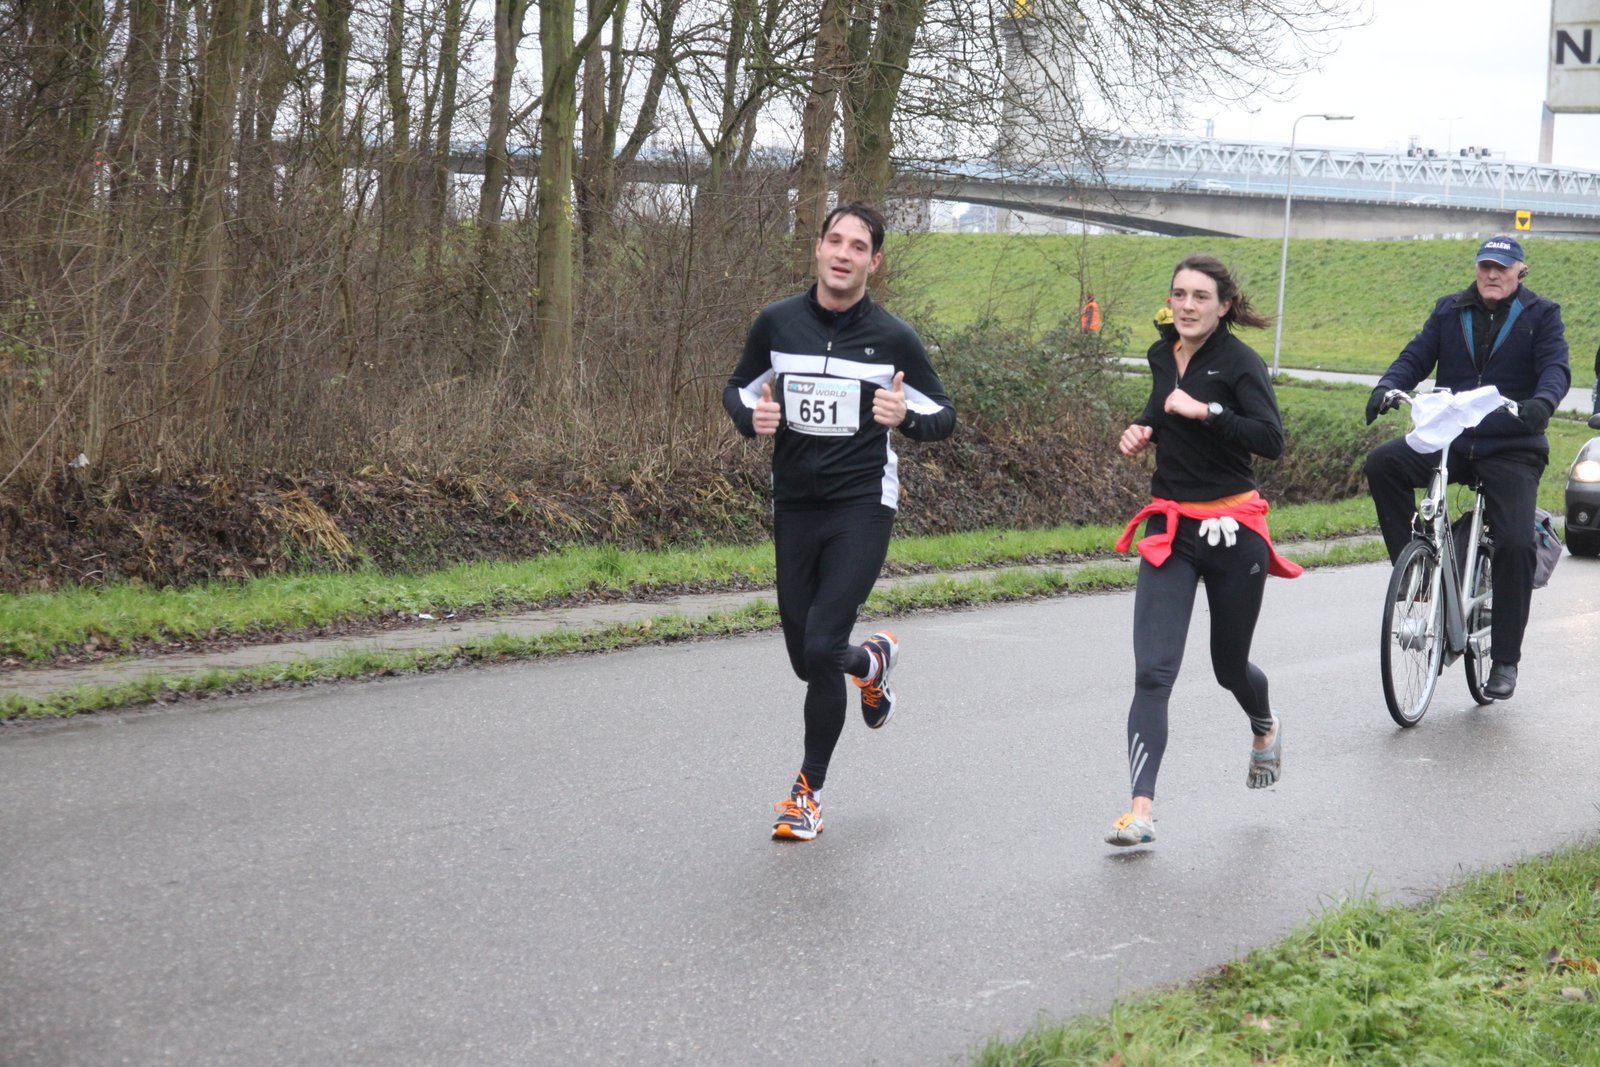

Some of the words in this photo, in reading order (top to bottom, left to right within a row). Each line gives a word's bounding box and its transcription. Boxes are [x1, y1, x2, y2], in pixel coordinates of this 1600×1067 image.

[1556, 29, 1600, 65] N
[815, 390, 847, 398] WORLD
[800, 399, 838, 425] 651
